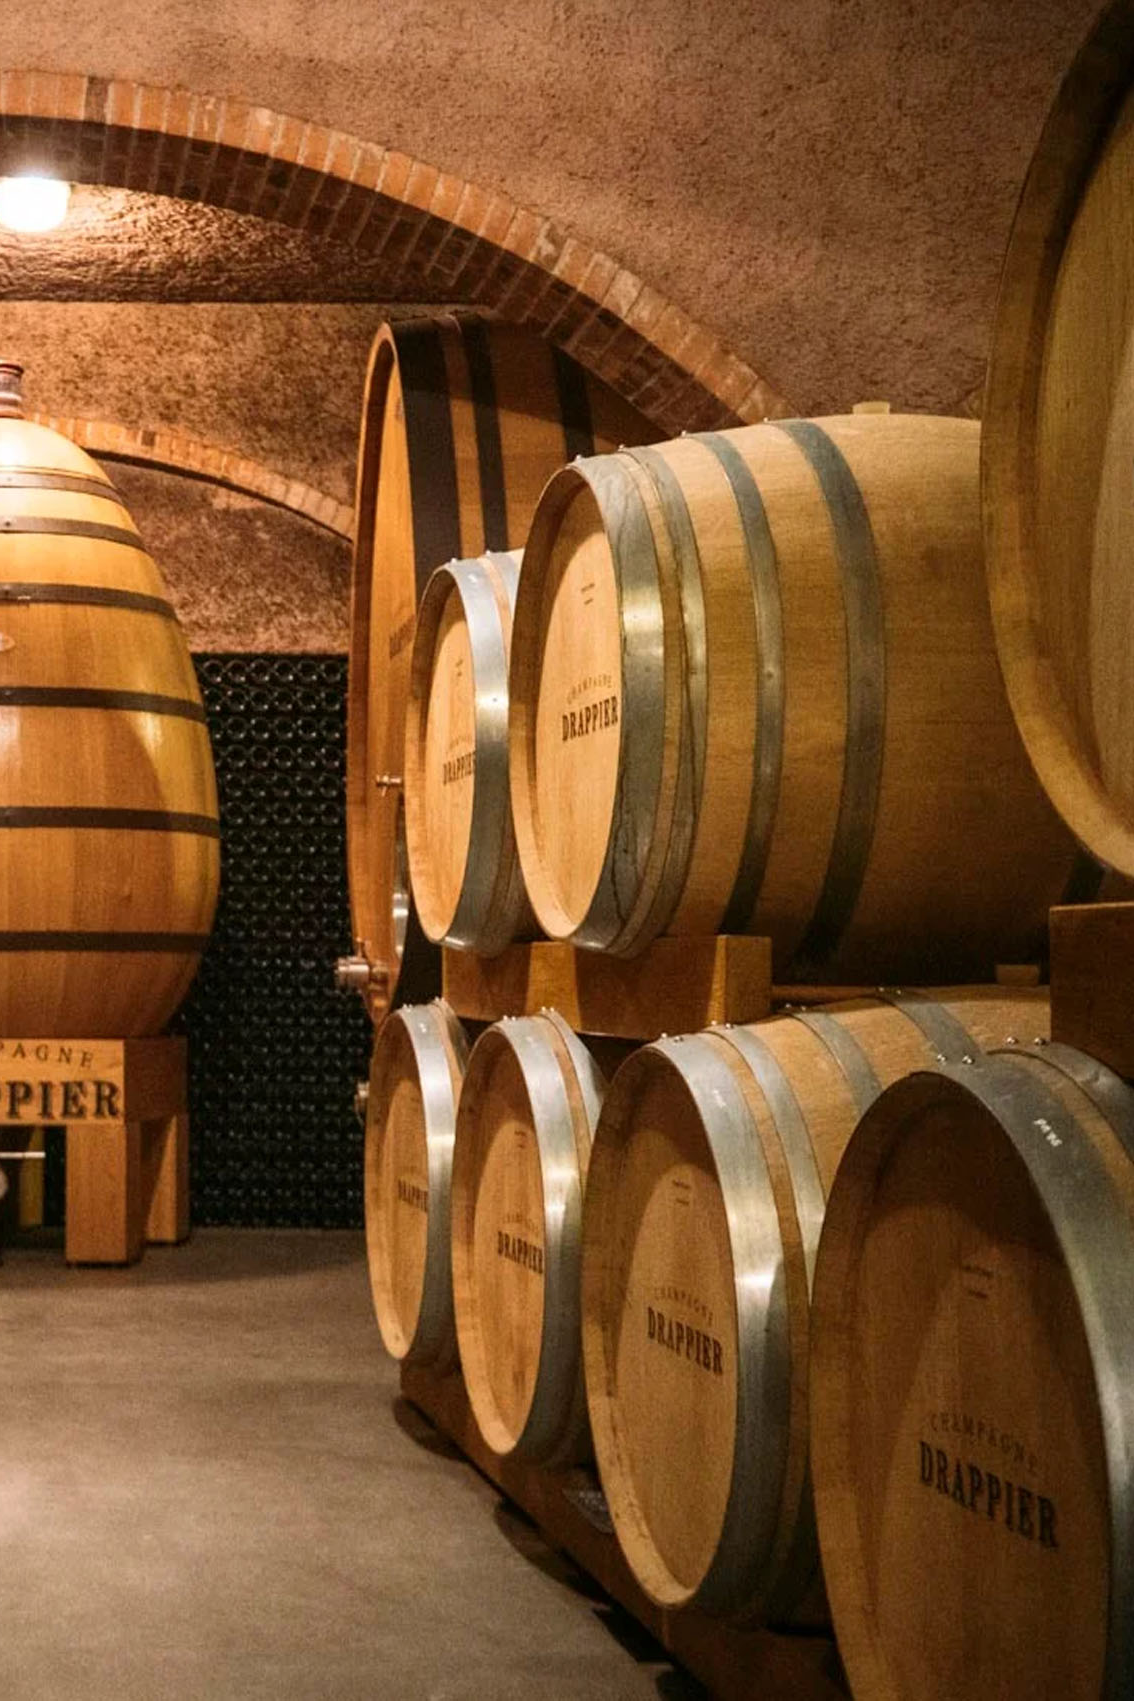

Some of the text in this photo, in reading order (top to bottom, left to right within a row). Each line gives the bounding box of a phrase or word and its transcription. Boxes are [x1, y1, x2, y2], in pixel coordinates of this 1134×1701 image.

[562, 696, 618, 742] DRAPPIER
[647, 1306, 723, 1375] DRAPPIER
[919, 1440, 1060, 1549] DRAPPIER
